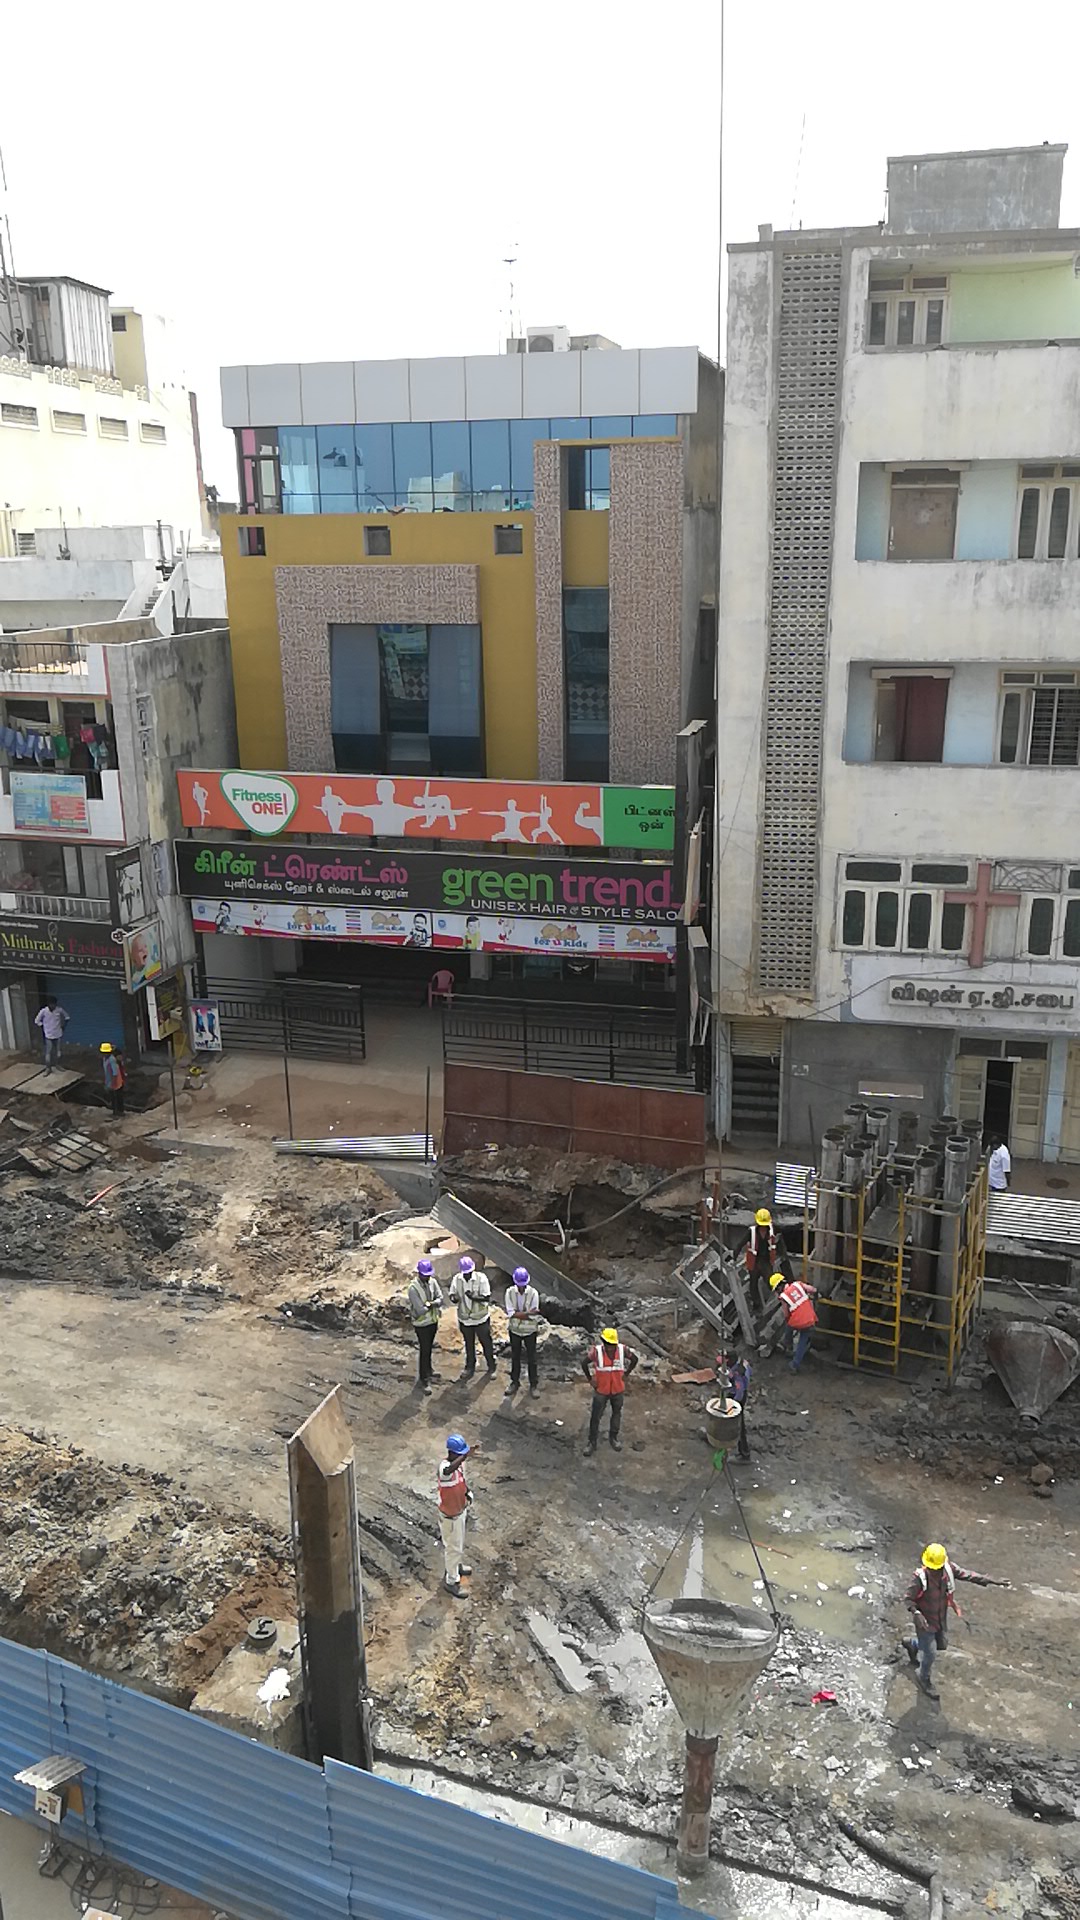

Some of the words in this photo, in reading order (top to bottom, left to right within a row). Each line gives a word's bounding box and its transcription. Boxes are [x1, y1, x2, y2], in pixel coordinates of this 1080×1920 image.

[232, 788, 282, 802] Fitness
[252, 802, 284, 815] ONE
[639, 818, 664, 832] ஒன்
[194, 849, 257, 875] கிரீன்
[263, 854, 408, 884] ட்ரெண்ட்ஸ்
[224, 878, 282, 891] யுனிசெக்ஸ்
[285, 881, 313, 895] ஹேர்
[316, 883, 324, 893] &
[328, 884, 372, 896] ஸ்டைல்
[374, 887, 409, 900] சலூன்
[442, 867, 554, 905] green
[559, 868, 681, 909] trend
[471, 899, 526, 912] UNISEX
[529, 903, 567, 915] HAIR
[581, 907, 631, 919] STYLE
[634, 909, 678, 921] SALO
[287, 922, 303, 931] for
[314, 922, 337, 932] kids
[1, 932, 65, 952] Mithraa's
[534, 937, 550, 946] for
[563, 939, 588, 948] kids
[11, 951, 56, 961] FAMILY
[60, 956, 124, 967] BOUTIQUE
[891, 982, 965, 1007] விஷன்
